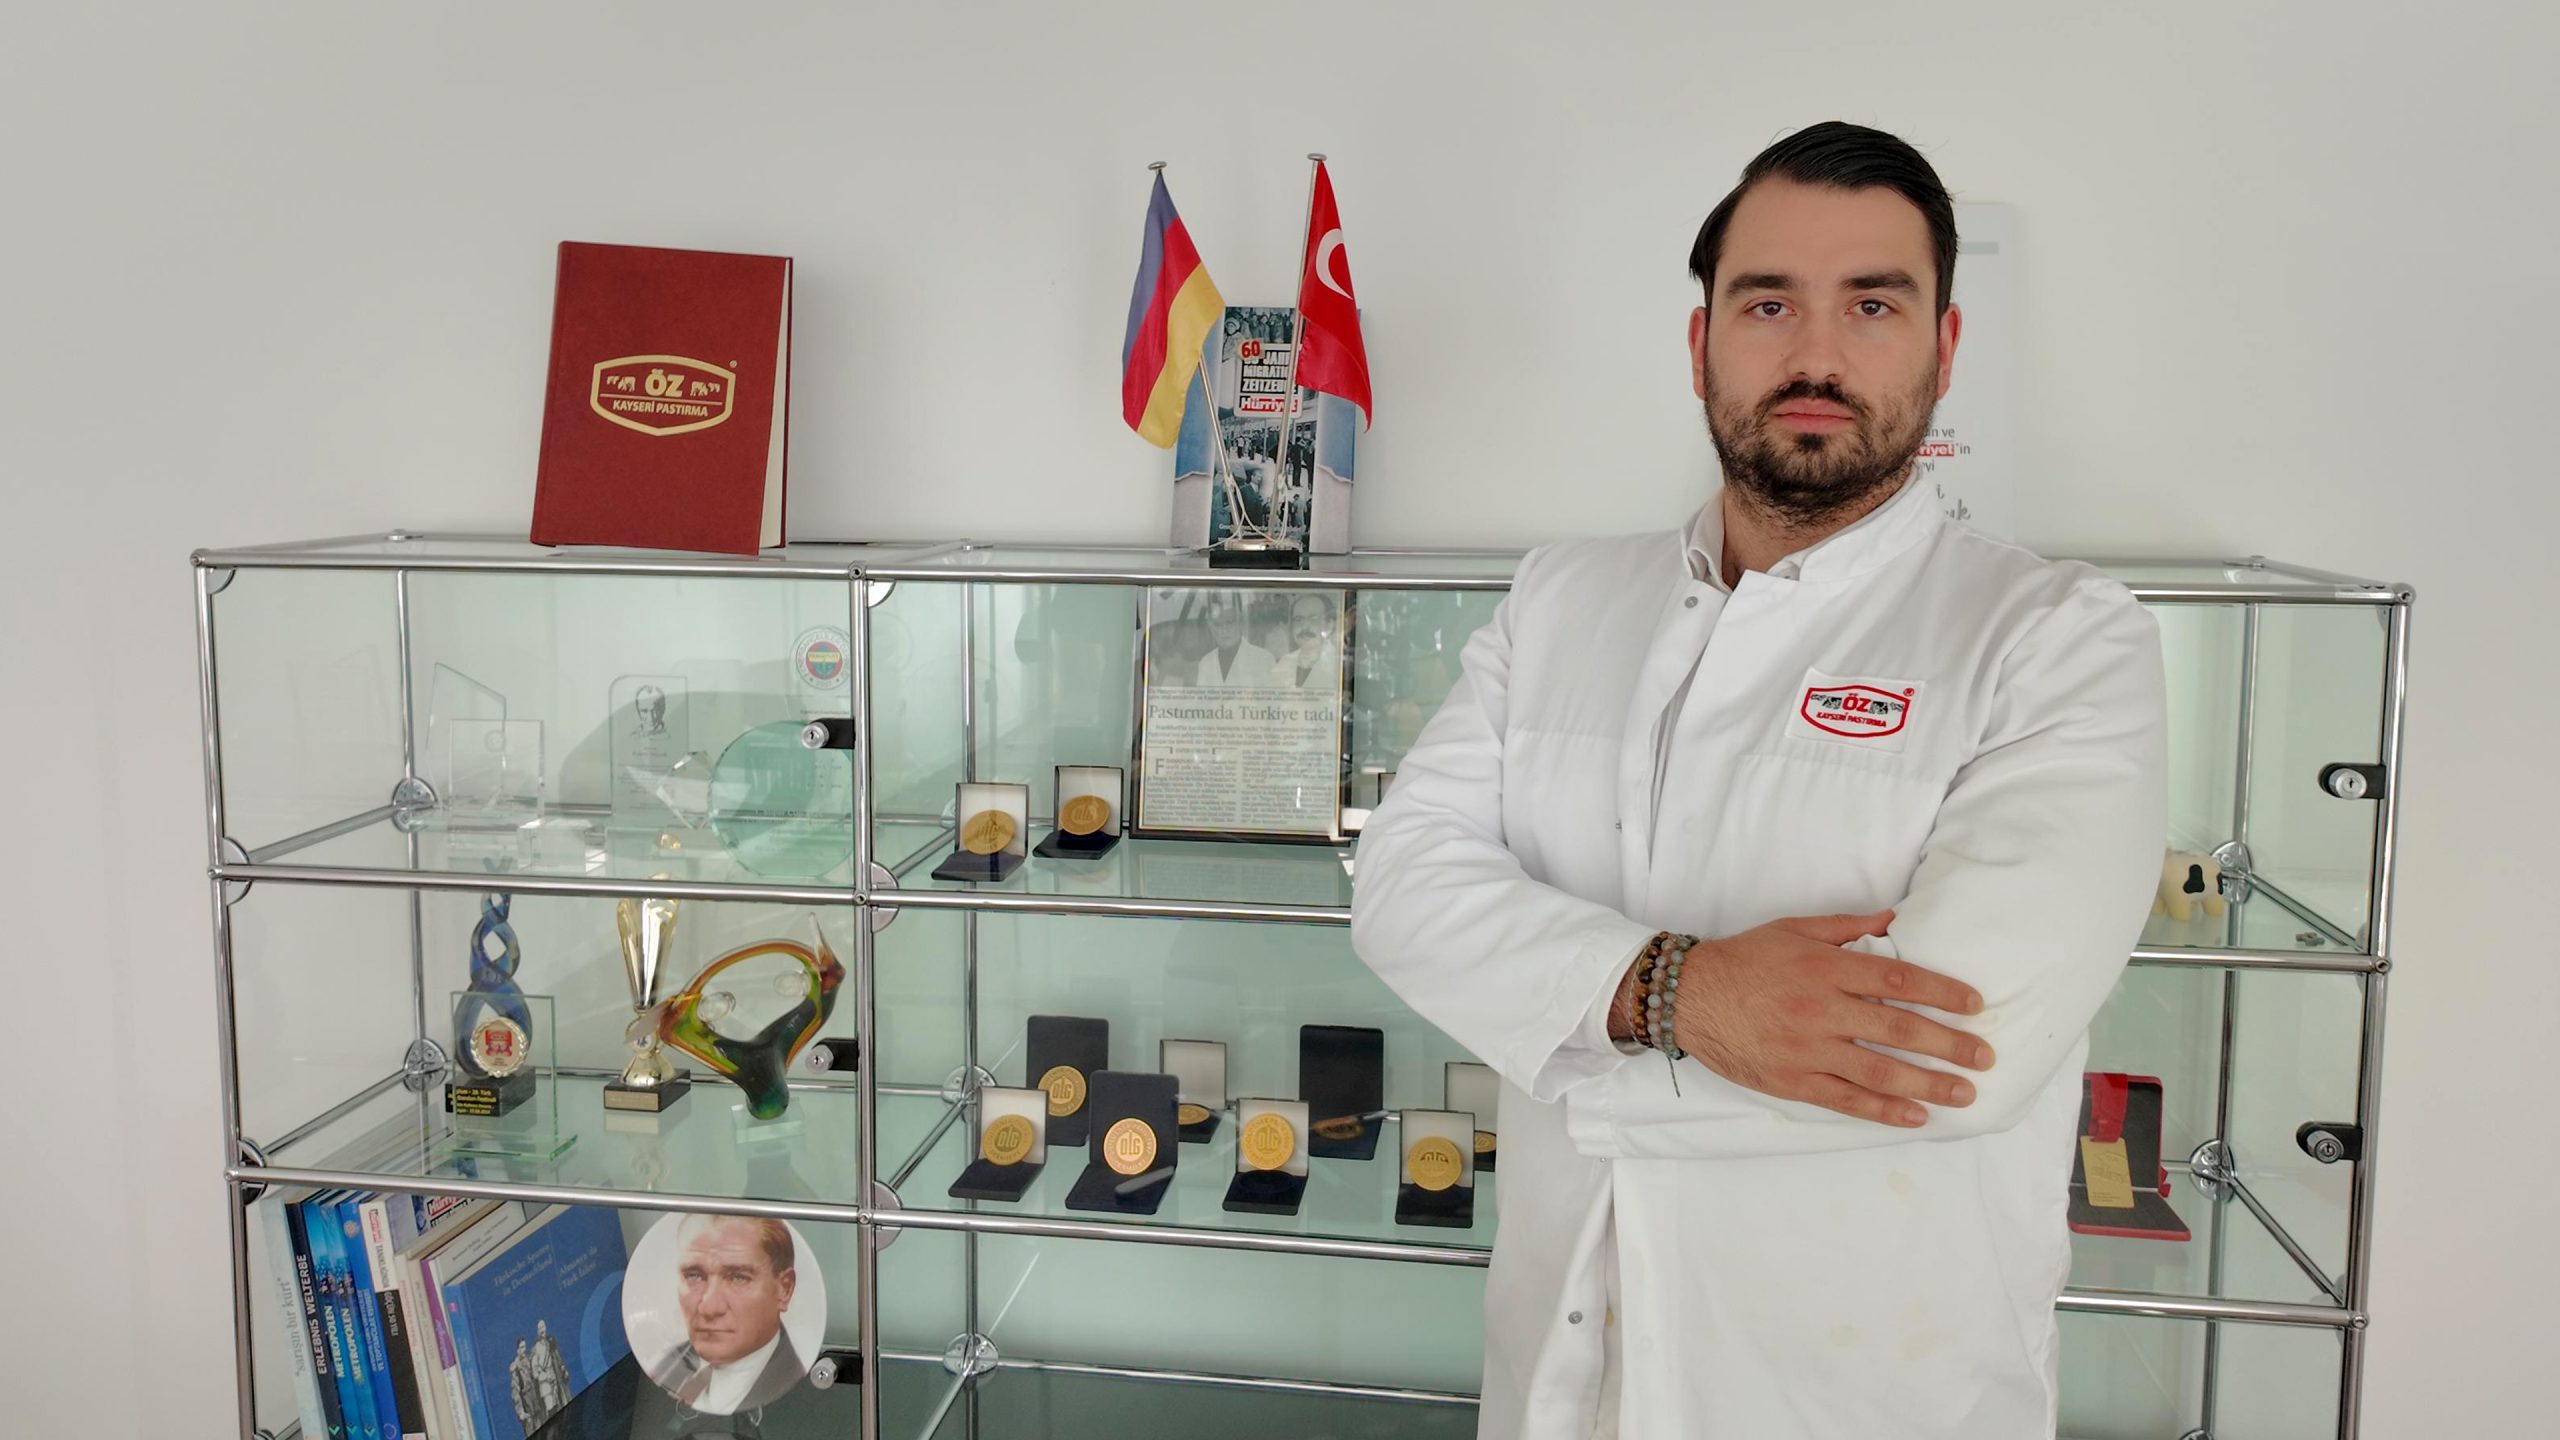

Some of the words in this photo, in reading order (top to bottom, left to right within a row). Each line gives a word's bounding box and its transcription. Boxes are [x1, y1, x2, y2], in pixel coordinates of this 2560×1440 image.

[1241, 340, 1261, 358] 60
[645, 368, 685, 397] ÖZ
[612, 400, 655, 414] KAYSERİ
[656, 402, 708, 417] PASTIRMA
[1150, 704, 1233, 721] Pastırmada
[1239, 705, 1299, 724] Türkiye
[1304, 706, 1334, 722] tadı
[1842, 693, 1871, 713] ÖZ
[1120, 1131, 1141, 1155] DLG
[297, 1254, 316, 1315] WELTERBE
[309, 1318, 328, 1375] ERLEBNIS
[324, 1305, 345, 1378] METROPOLEN
[341, 1308, 363, 1382] METROPOLEN
